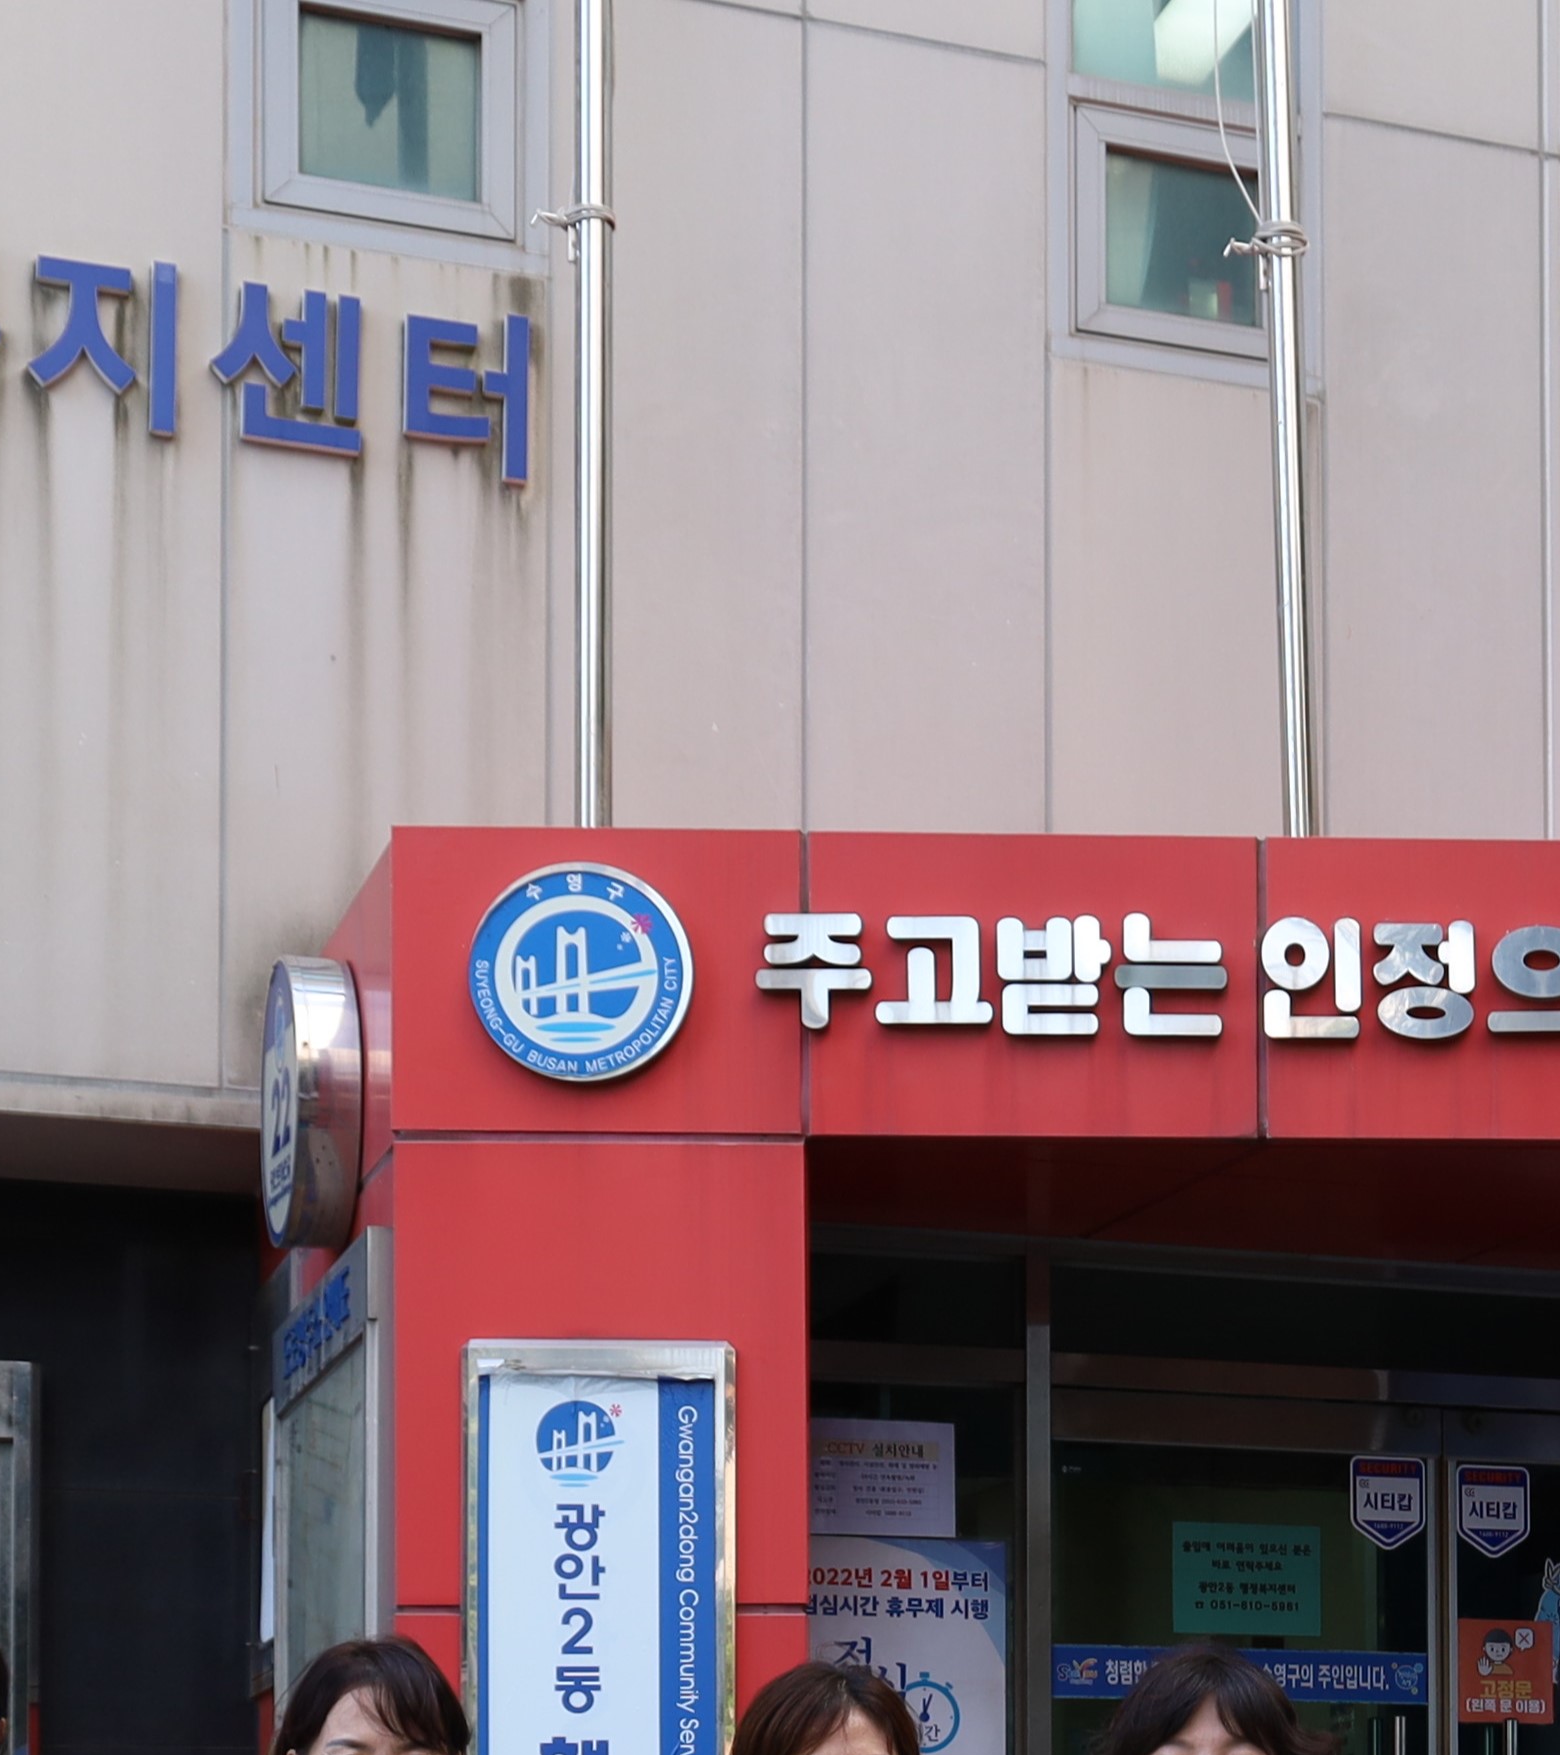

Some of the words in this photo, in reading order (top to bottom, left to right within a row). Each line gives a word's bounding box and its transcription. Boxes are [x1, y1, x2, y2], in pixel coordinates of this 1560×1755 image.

[525, 872, 626, 901] 수영구
[755, 911, 1226, 1040] 주고받는
[474, 958, 525, 1055] SUYEONG-GU
[526, 1049, 579, 1075] BUSAN
[584, 998, 675, 1075] METROPOLITAN
[662, 955, 678, 992] CITY
[271, 1076, 293, 1158] 22
[872, 1442, 924, 1458] 설치안내
[1359, 1462, 1418, 1476] SECURITY
[1464, 1470, 1522, 1483] SECURITY
[675, 1404, 699, 1583] Gwangan2dong
[1362, 1491, 1414, 1512] 시티캅
[1468, 1501, 1519, 1521] 시티캅
[880, 1567, 913, 1590] 2월
[920, 1569, 989, 1592] 1일부터
[552, 1502, 606, 1714] 광안2동
[886, 1596, 945, 1620] 휴무제
[951, 1598, 989, 1621] 시행
[675, 1588, 699, 1713] Community
[1317, 1665, 1390, 1691] 주인입니다.
[1479, 1680, 1533, 1700] 고정문
[1465, 1698, 1498, 1714] (왼쪽
[1500, 1699, 1513, 1714] 문
[1515, 1699, 1546, 1715] 이용)
